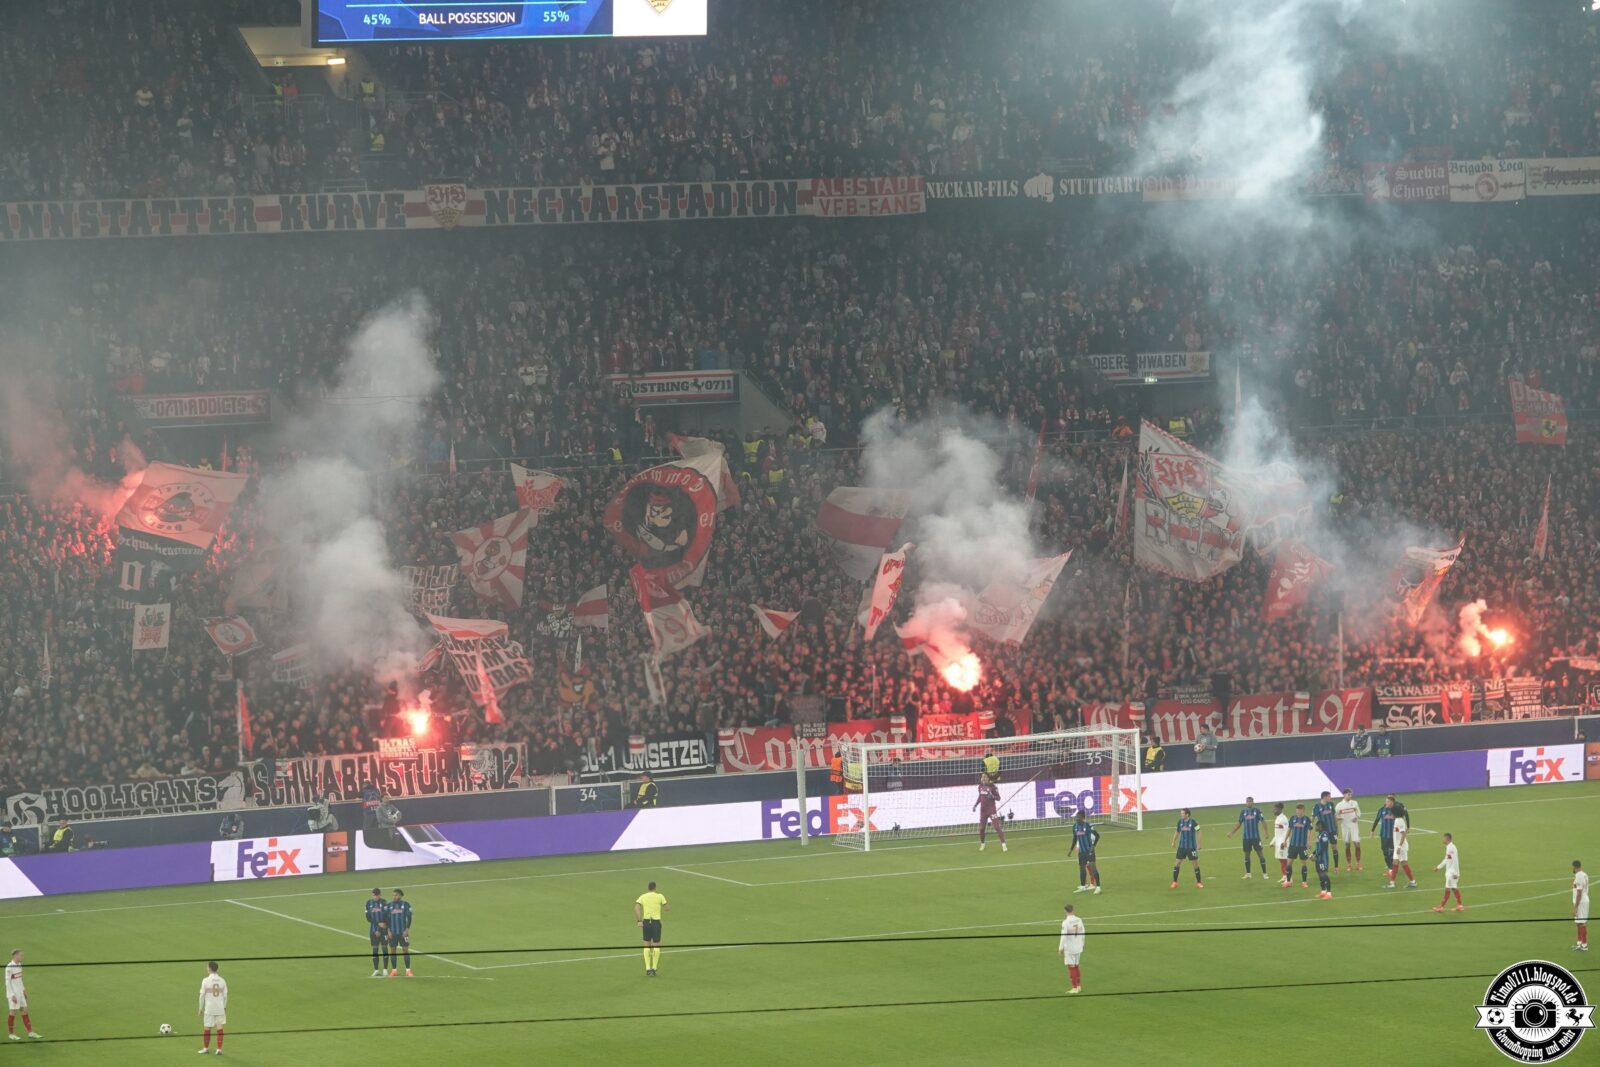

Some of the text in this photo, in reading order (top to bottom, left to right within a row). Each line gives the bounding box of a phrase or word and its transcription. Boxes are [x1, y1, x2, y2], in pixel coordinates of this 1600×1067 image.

[363, 14, 391, 25] 45%
[418, 12, 515, 25] BALL POSSESSION
[543, 11, 570, 23] 55%
[1395, 165, 1445, 180] Suebia
[1449, 161, 1493, 175] Brigada
[816, 176, 924, 196] ALBSTADT
[926, 180, 1019, 199] NECKAR-FILS
[1059, 176, 1143, 196] STUTTGART
[279, 193, 406, 232] KURVE
[484, 181, 798, 225] NECKARSTADION
[819, 195, 921, 215] VFB-FANS
[1092, 354, 1187, 370] OBERSHWABEN
[704, 380, 731, 390] 0711
[188, 398, 246, 415] ADDICTS
[1319, 691, 1364, 732] 97
[927, 723, 964, 739] SZENE
[1086, 753, 1102, 766] 35
[41, 777, 217, 816] HOOLIGANS
[579, 787, 598, 802] 34
[1035, 776, 1148, 818] FedEx
[761, 794, 879, 838] FedEx
